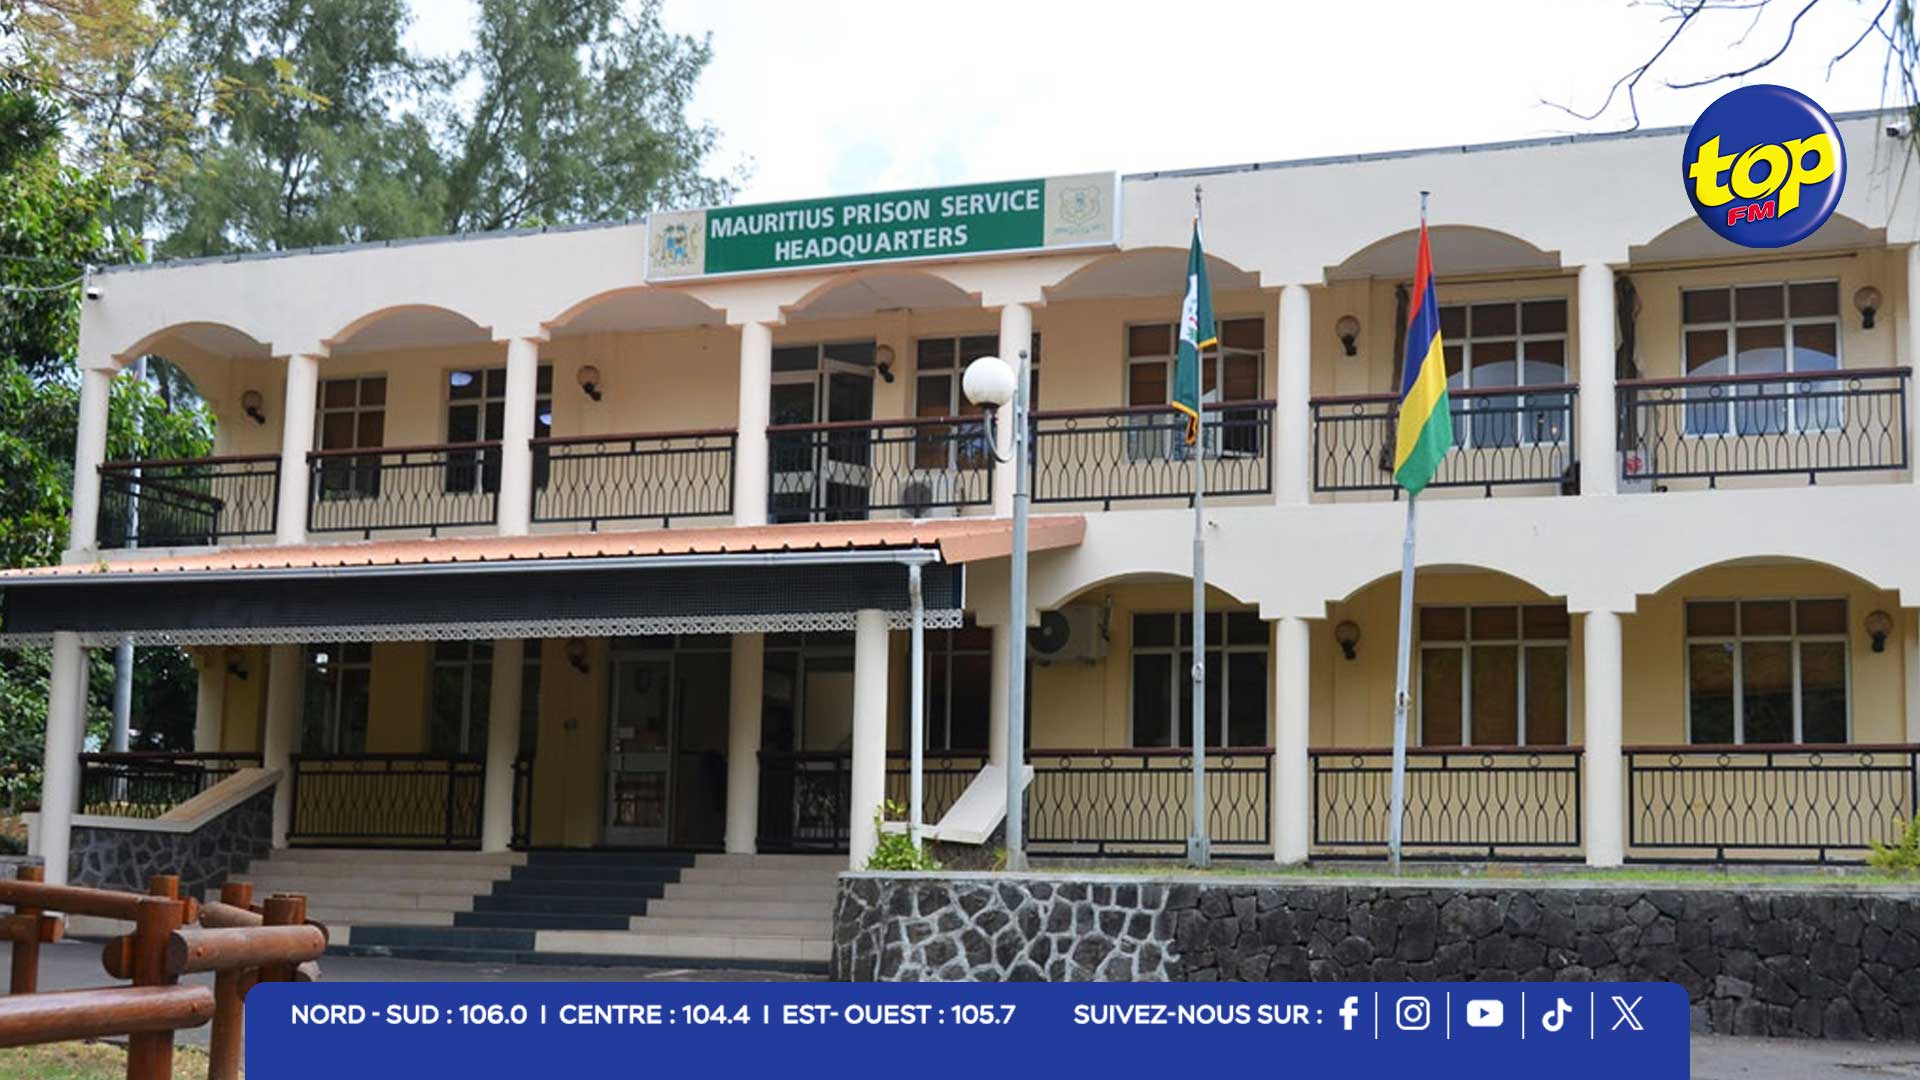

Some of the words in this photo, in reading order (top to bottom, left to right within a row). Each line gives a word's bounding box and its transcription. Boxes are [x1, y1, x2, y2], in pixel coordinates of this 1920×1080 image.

[711, 206, 835, 239] MAURITIUS
[843, 198, 930, 227] PRISON
[941, 189, 1040, 218] SERVICE
[775, 224, 969, 262] HEADQUARTERS
